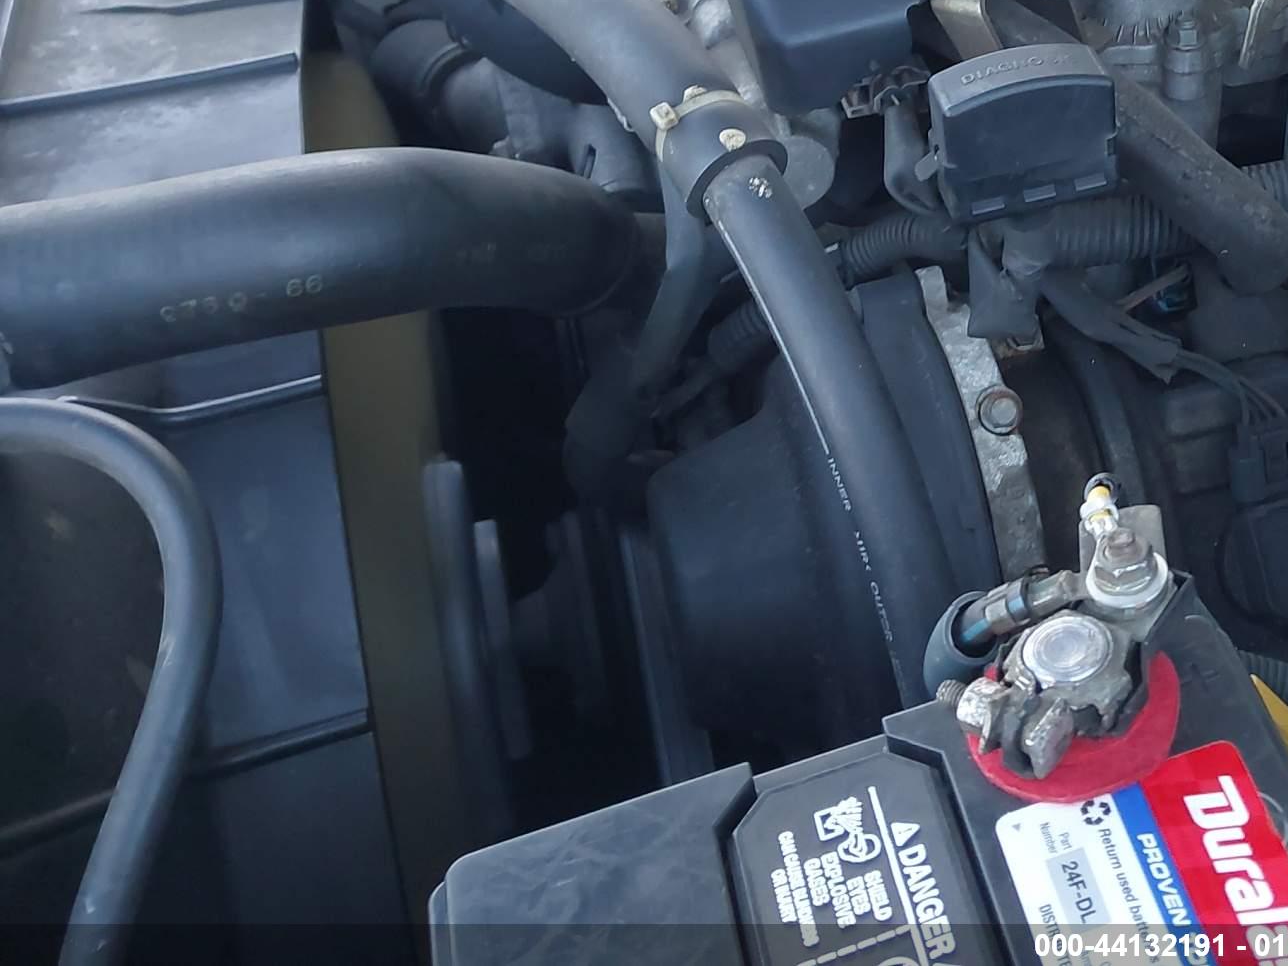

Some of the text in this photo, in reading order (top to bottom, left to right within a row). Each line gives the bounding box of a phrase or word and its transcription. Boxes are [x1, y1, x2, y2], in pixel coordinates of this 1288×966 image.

[827, 457, 852, 511] INNER
[870, 581, 893, 642] OUTER
[1039, 821, 1059, 854] Number
[1059, 831, 1073, 851] Part
[1098, 828, 1123, 869] Return
[1116, 872, 1139, 903] used
[803, 857, 830, 906] GASES
[820, 851, 856, 929] EXPLOSIVE
[846, 876, 871, 915] EYES
[864, 870, 893, 921] SHIELD
[898, 843, 956, 960] DANGER
[1061, 861, 1096, 924] 24F-DL
[1136, 833, 1192, 928] PROVEN
